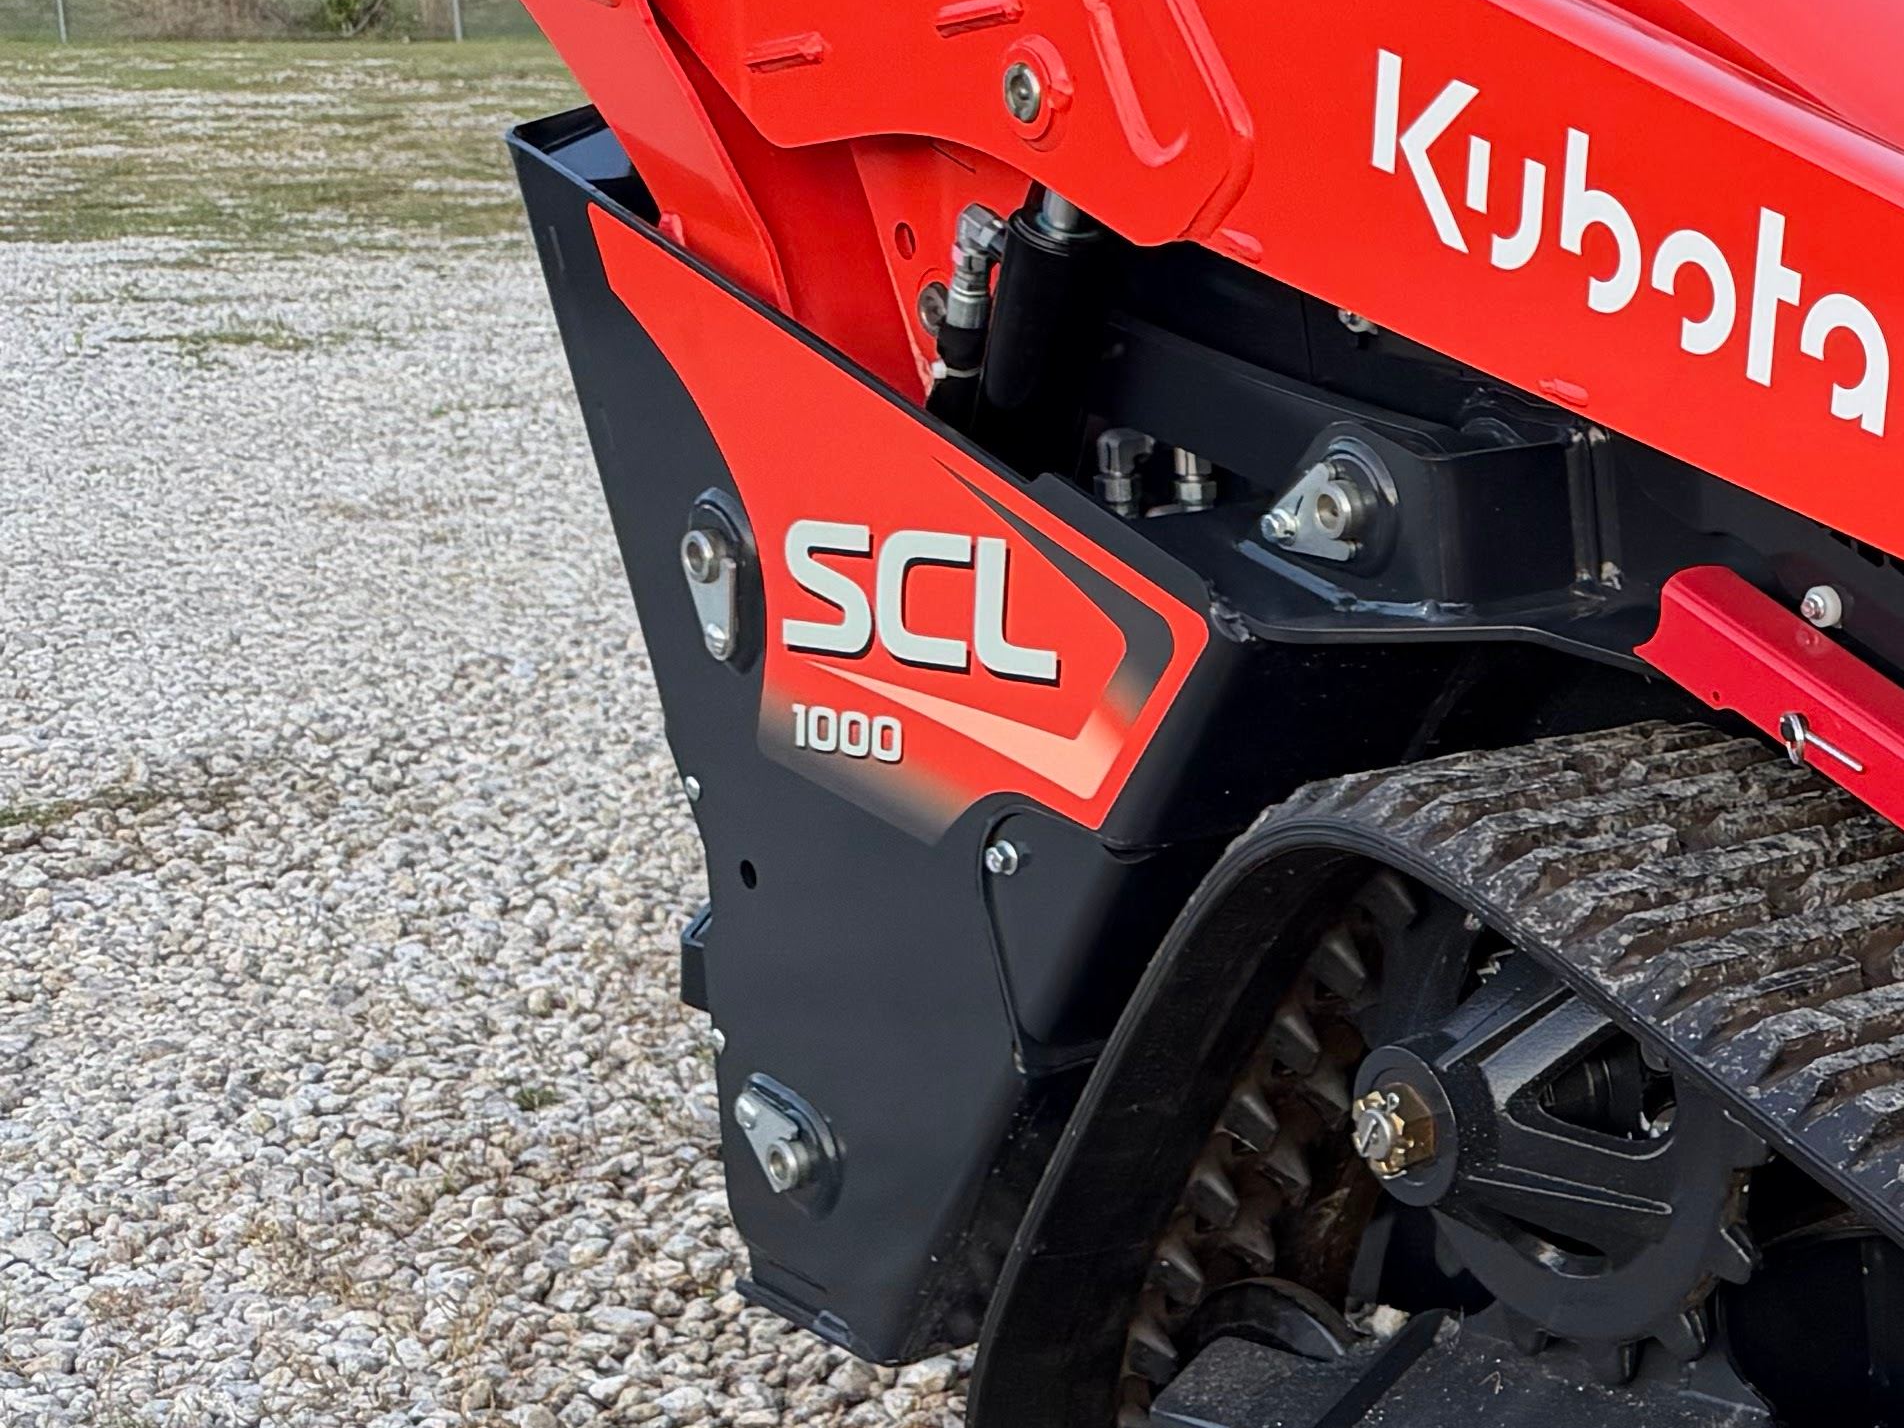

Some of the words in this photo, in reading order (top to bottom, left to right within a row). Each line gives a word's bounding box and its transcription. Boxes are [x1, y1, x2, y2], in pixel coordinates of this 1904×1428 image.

[1371, 47, 1889, 438] Kubota
[782, 519, 1060, 686] SCL
[791, 703, 903, 763] 1000
